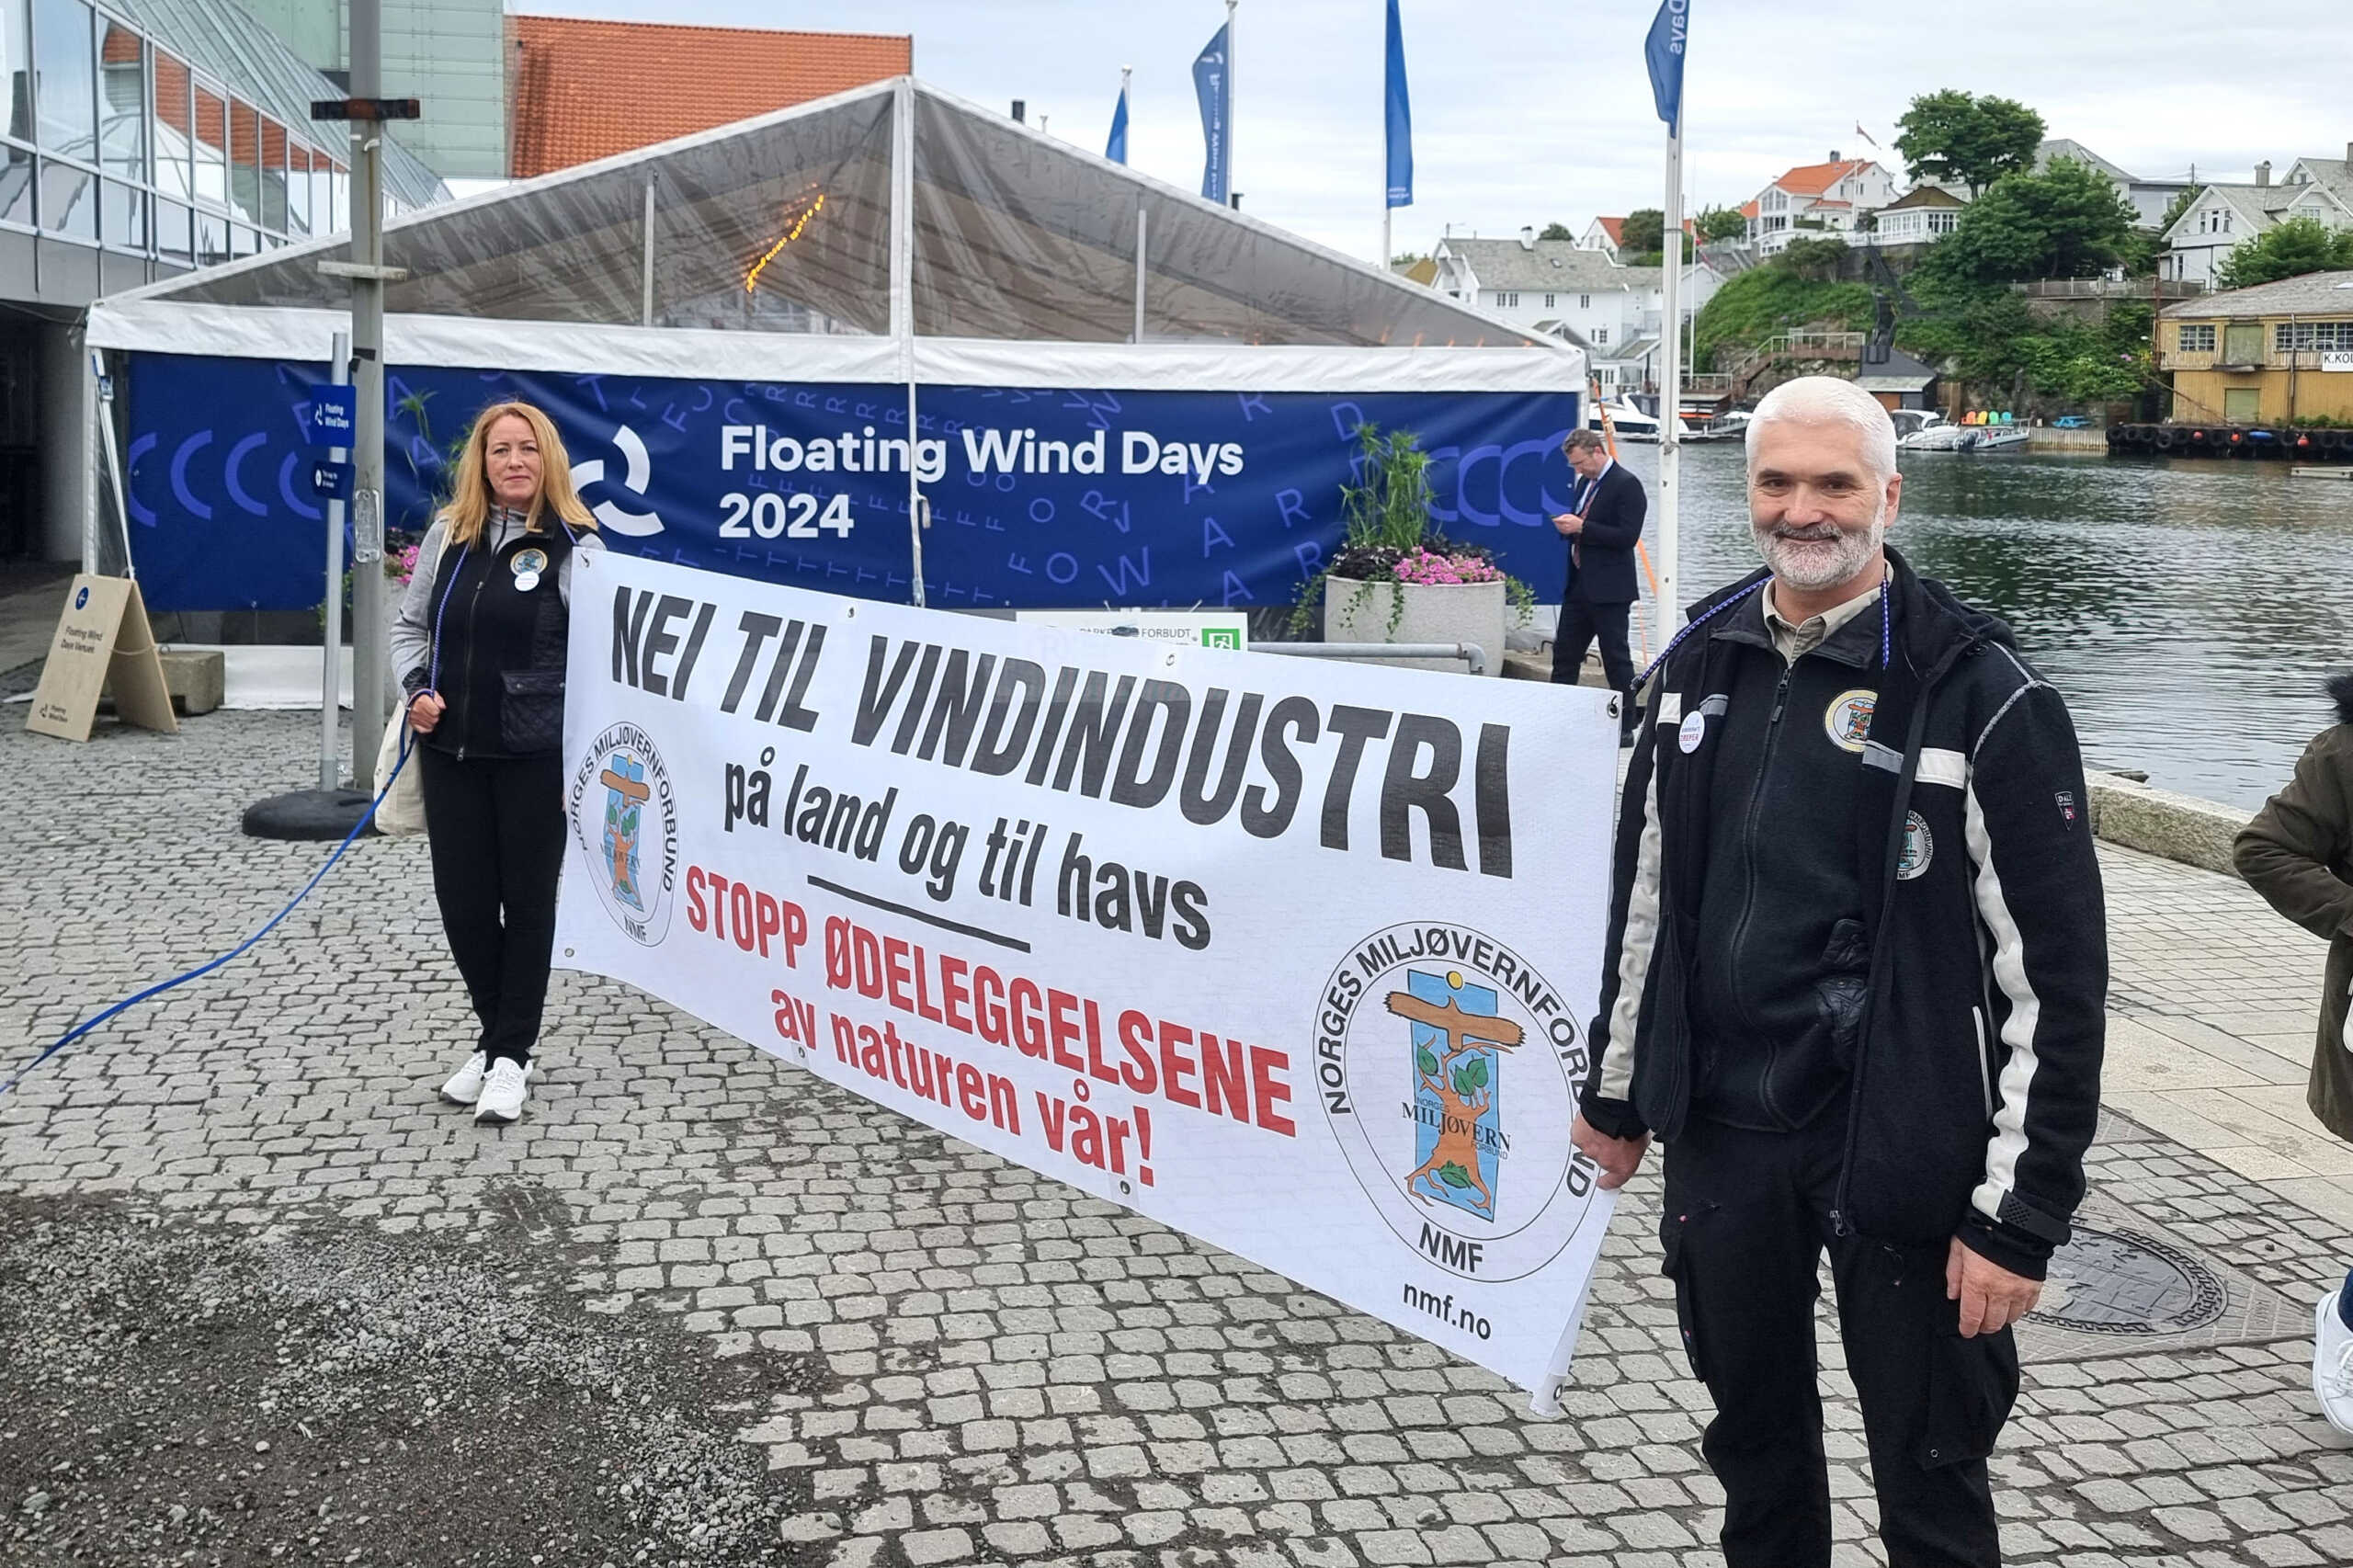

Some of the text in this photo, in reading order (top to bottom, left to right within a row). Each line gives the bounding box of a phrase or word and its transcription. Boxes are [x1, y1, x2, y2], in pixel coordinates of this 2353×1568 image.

[721, 425, 1245, 486] Floating Wind Days
[718, 492, 855, 540] 2024
[1141, 628, 1192, 639] FORBUDT
[612, 585, 1513, 880] NEI TIL VINDINDUSTRI
[593, 726, 678, 892] MILJØVERNFORBUND
[724, 745, 1211, 951] på land og til havs
[624, 915, 648, 943] NMF
[686, 864, 1296, 1139] STOPP ØDELEGGELSENE
[1317, 970, 1362, 1116] NORGES
[770, 988, 1155, 1187] av naturen vår!
[1416, 1096, 1449, 1113] NORGES
[1402, 1101, 1511, 1153] MILJØVERN
[1471, 1141, 1508, 1160] FORBUND
[1419, 1221, 1484, 1272] NMF
[1404, 1282, 1493, 1341] nmf.no
